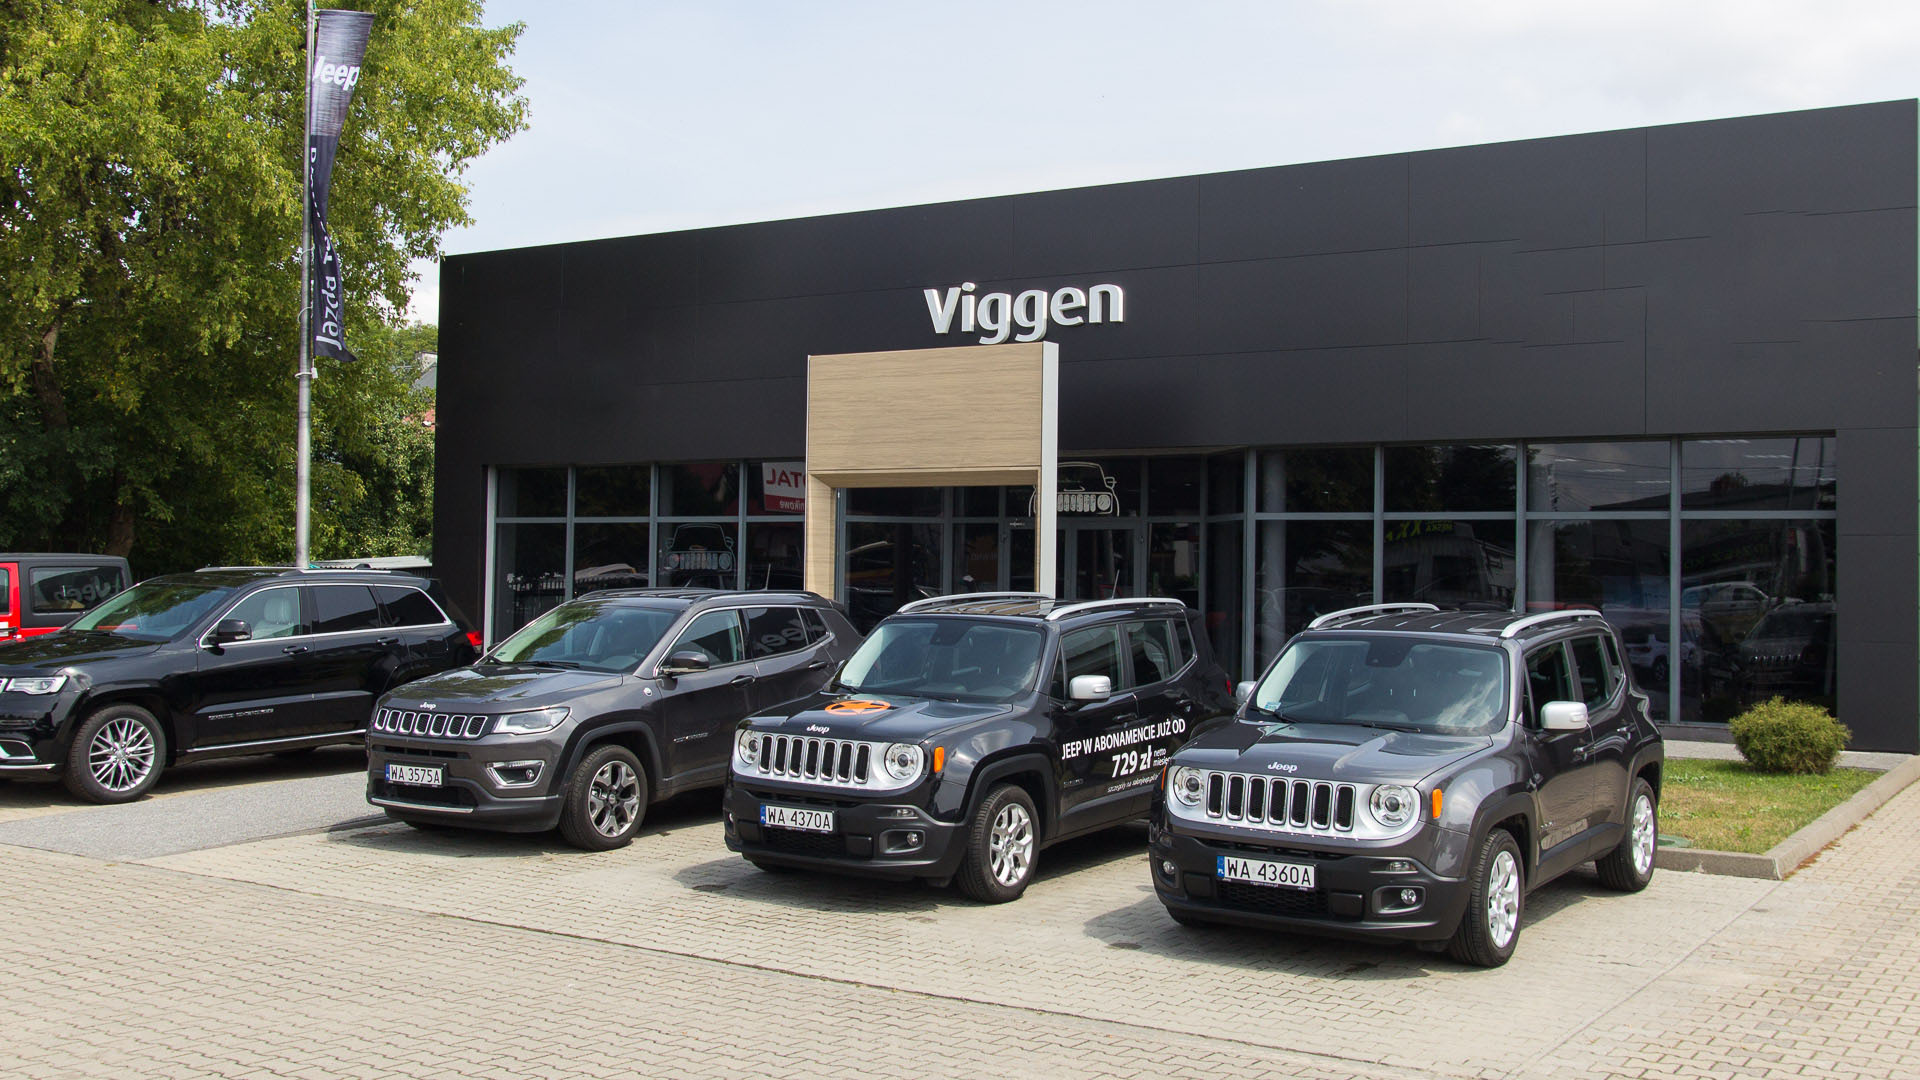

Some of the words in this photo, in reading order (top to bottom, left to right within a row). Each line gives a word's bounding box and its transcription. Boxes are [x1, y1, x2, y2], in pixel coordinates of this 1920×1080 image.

[314, 56, 360, 91] Jeep
[315, 276, 342, 350] Jazda
[923, 281, 1124, 345] Viggen
[806, 724, 830, 735] Jeep
[1062, 740, 1082, 760] JEEP
[1083, 738, 1092, 754] W
[1094, 725, 1155, 753] ABONAMENCIE
[1156, 719, 1171, 738] JUŻ
[1172, 719, 1186, 734] OD
[391, 766, 404, 781] WA
[408, 768, 440, 784] 3575A
[1112, 750, 1138, 778] 729
[1139, 744, 1152, 771] zł
[1267, 761, 1298, 774] Jeep
[768, 808, 785, 825] WA
[791, 811, 831, 829] 4370A
[1227, 859, 1250, 879] WA
[1258, 863, 1311, 886] 4360A
